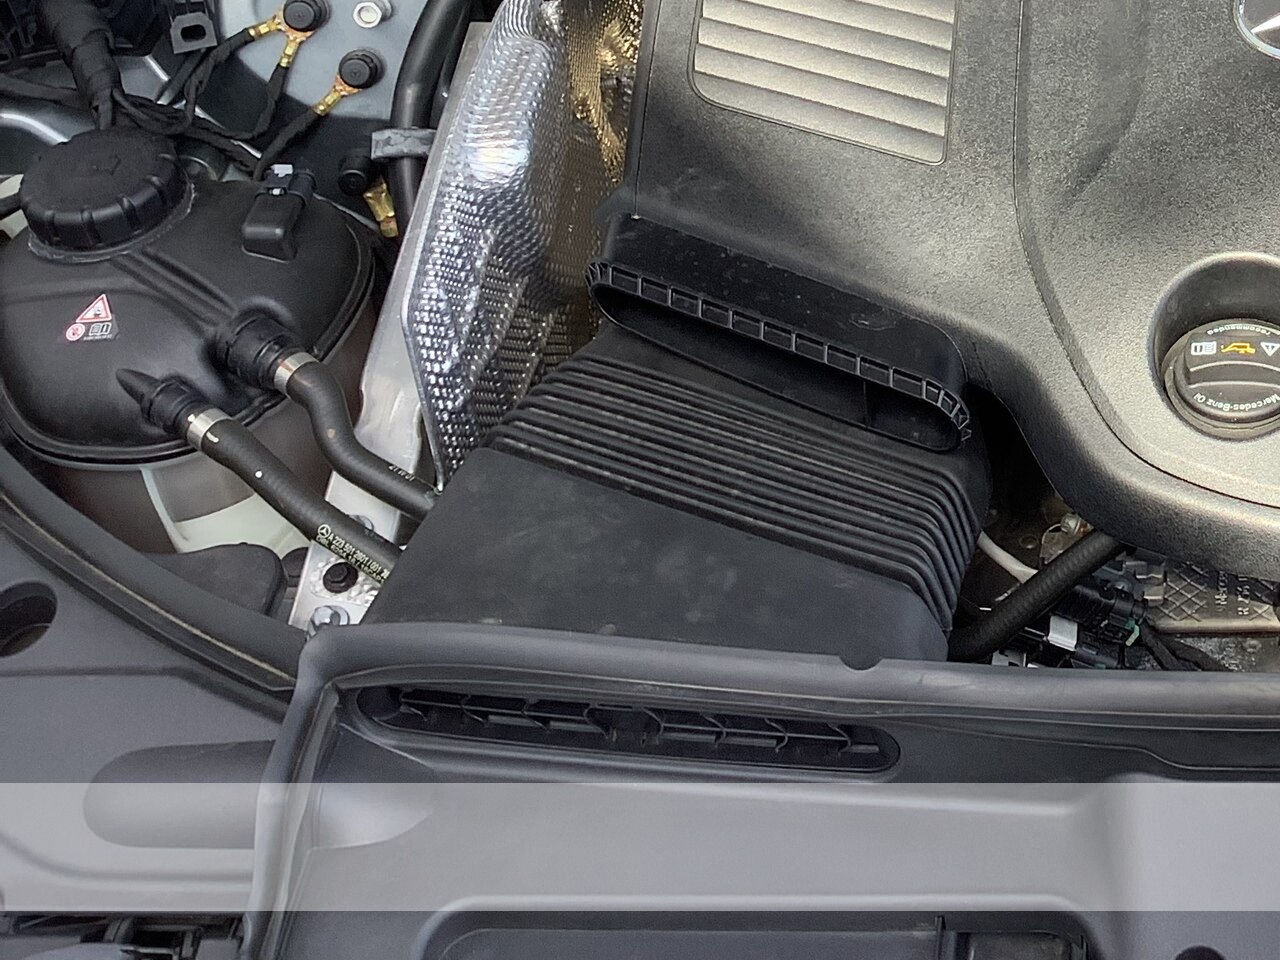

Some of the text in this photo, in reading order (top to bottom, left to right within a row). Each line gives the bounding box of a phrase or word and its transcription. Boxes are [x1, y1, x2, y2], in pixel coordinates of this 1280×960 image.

[1207, 324, 1272, 336] recommended
[1193, 392, 1280, 411] Mercedes-Benz Oil
